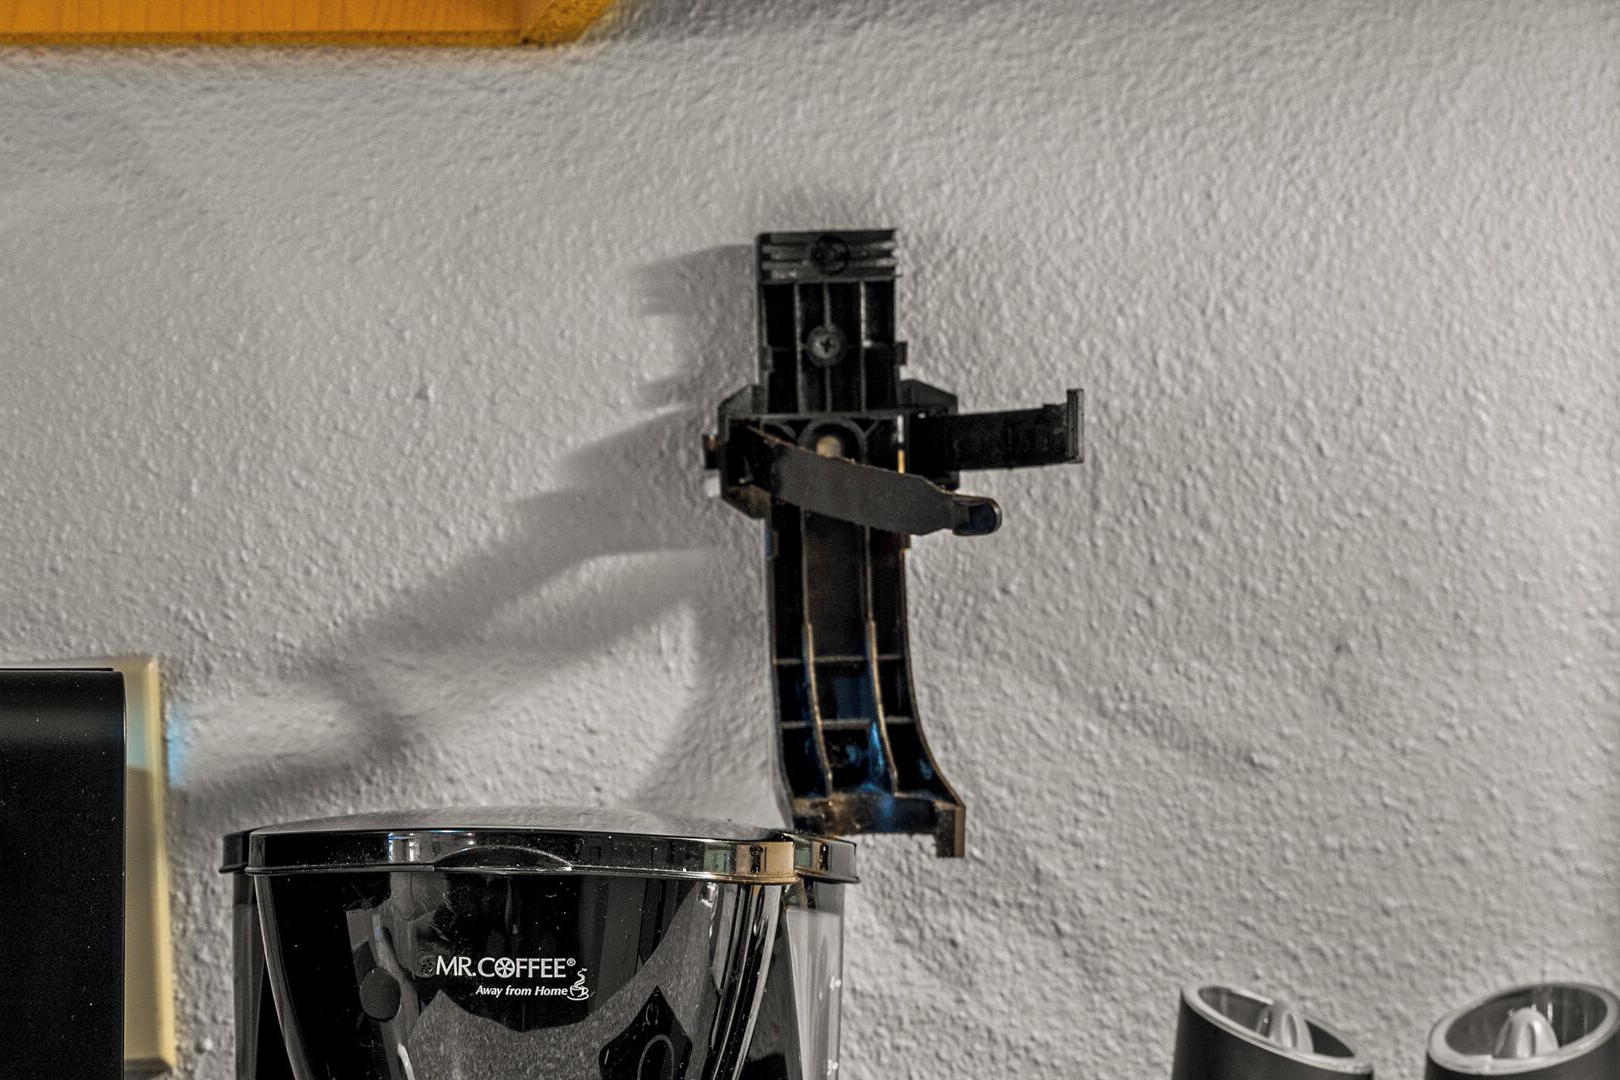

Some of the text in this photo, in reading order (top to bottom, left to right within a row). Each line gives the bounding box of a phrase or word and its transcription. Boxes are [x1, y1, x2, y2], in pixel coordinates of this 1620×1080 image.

[475, 984, 568, 998] Away from Home
